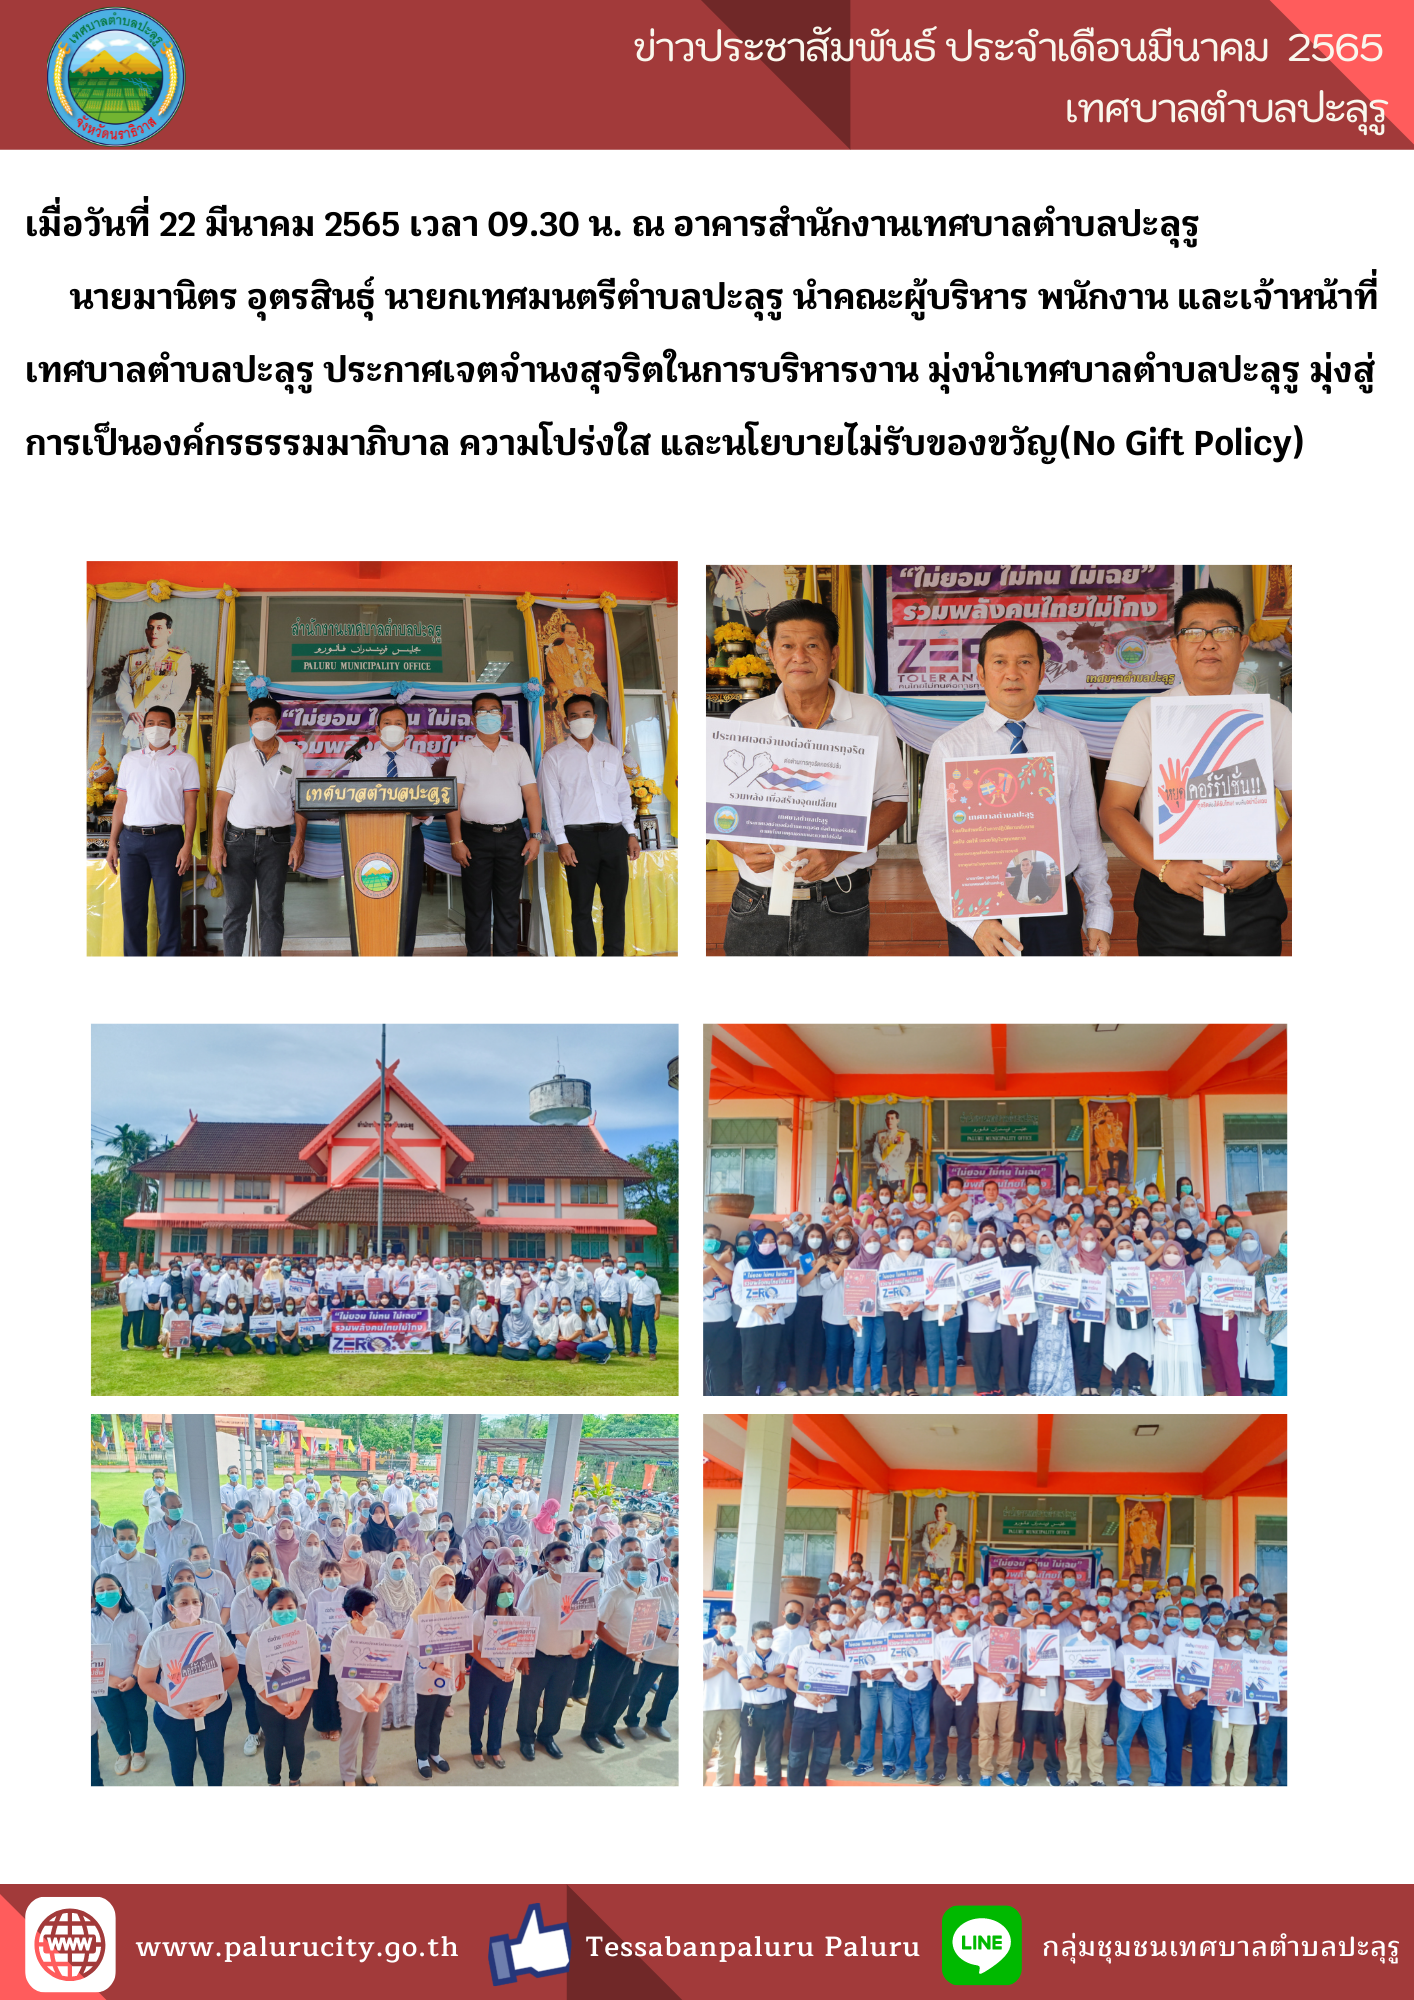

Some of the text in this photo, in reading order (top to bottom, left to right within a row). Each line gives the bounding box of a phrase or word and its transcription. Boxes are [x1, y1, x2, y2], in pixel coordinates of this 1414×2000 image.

[1000, 565, 1061, 586] ไม่ทน
[903, 595, 1158, 621] รวมพลังคนไทยไม่โกง
[291, 617, 442, 643] สำนักงานเทศบาลตำบลปะลุรู
[303, 661, 431, 670] PALURU MUNICIPALITY OFFICE
[1086, 671, 1175, 685] เทศบาลตำบลปะลุรู
[712, 731, 866, 756] ประกาศเจตจำนงต่อต้านการทุจริต
[1188, 766, 1261, 800] คอร์รัปชั่น!!
[306, 784, 451, 806] เทศบาลตำบลปะลุรู
[1165, 786, 1186, 808] หยุด
[335, 1322, 423, 1332] รวมพลังคนไทยไม่โกง
[333, 1337, 391, 1352] ZERO
